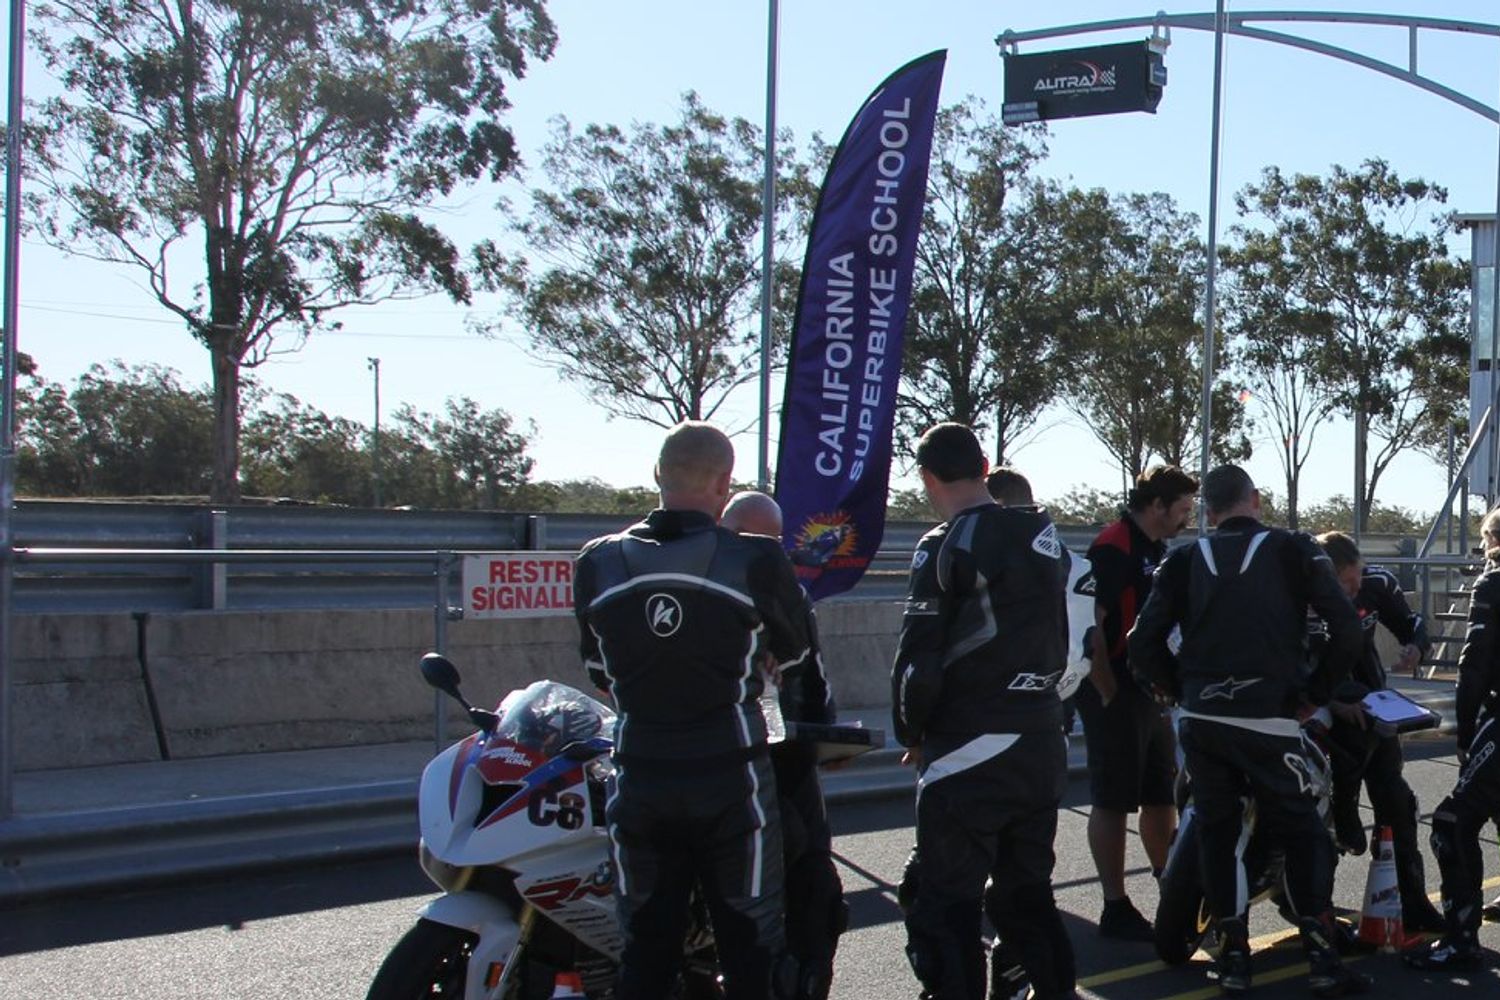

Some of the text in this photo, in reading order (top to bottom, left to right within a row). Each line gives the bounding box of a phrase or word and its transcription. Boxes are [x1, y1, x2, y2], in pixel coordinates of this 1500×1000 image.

[814, 251, 855, 477] CALIFORNIA
[849, 97, 911, 483] SUPERBIKE SCHOOL
[527, 789, 586, 831] C8
